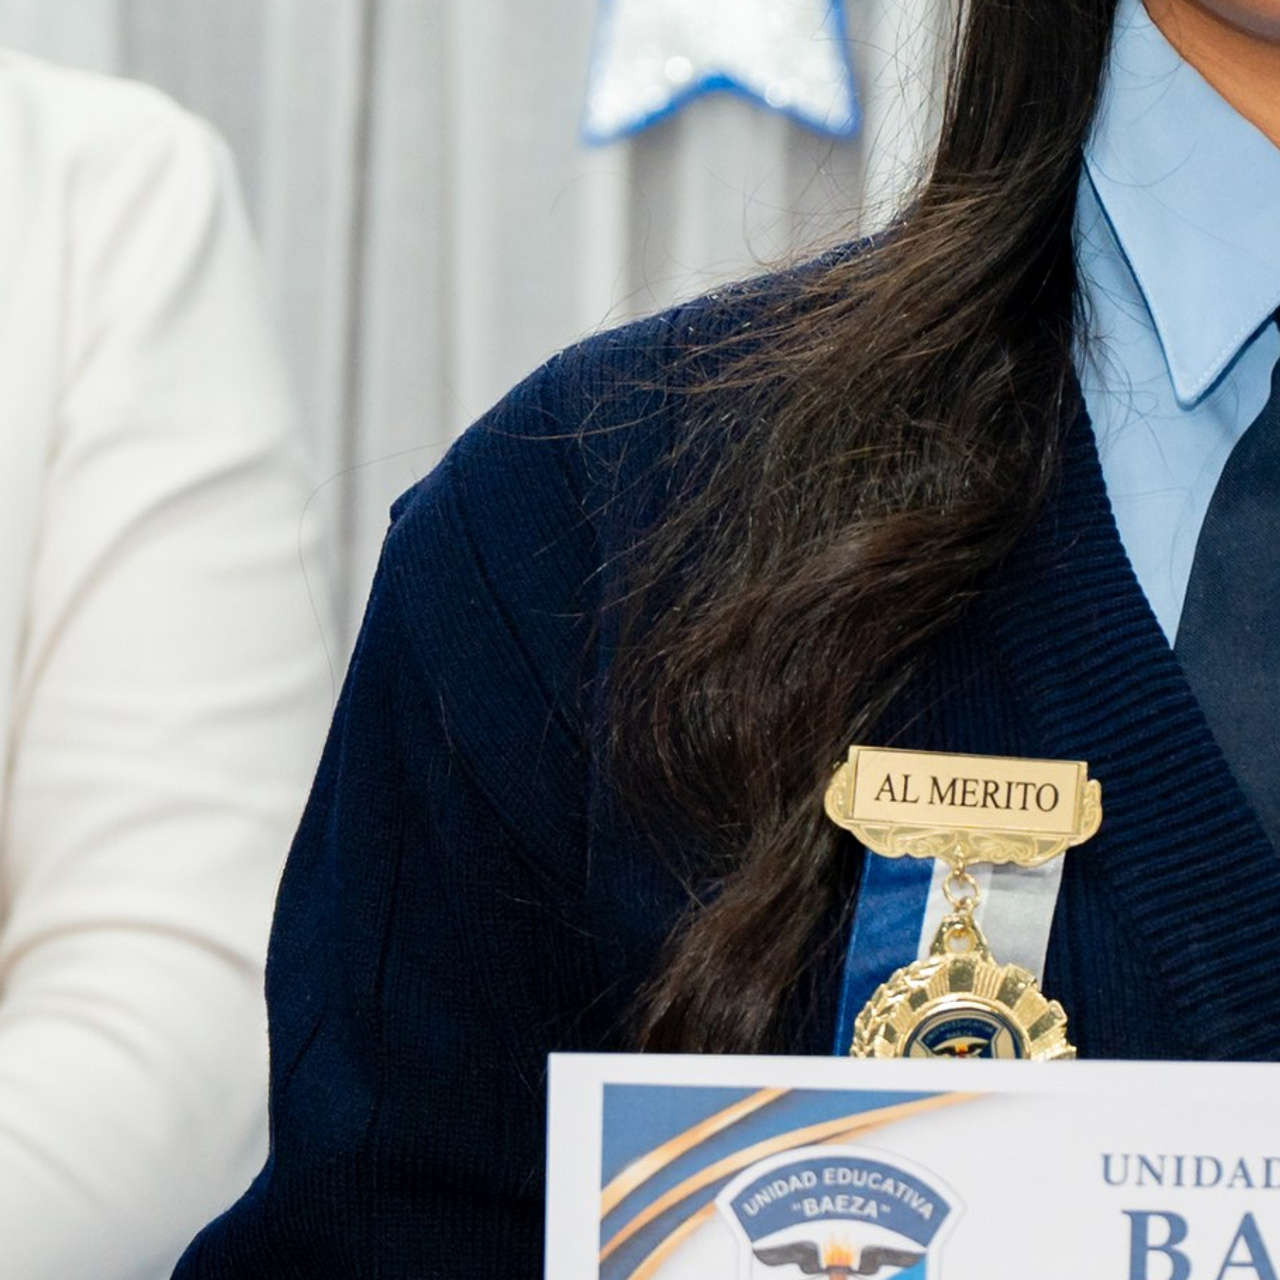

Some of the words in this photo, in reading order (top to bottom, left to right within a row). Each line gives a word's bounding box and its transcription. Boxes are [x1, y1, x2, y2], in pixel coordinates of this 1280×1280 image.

[873, 773, 921, 805] AL
[928, 776, 1060, 813] MERITO
[742, 1170, 818, 1218] UNIDAD
[822, 1167, 935, 1220] EDUCATIVA
